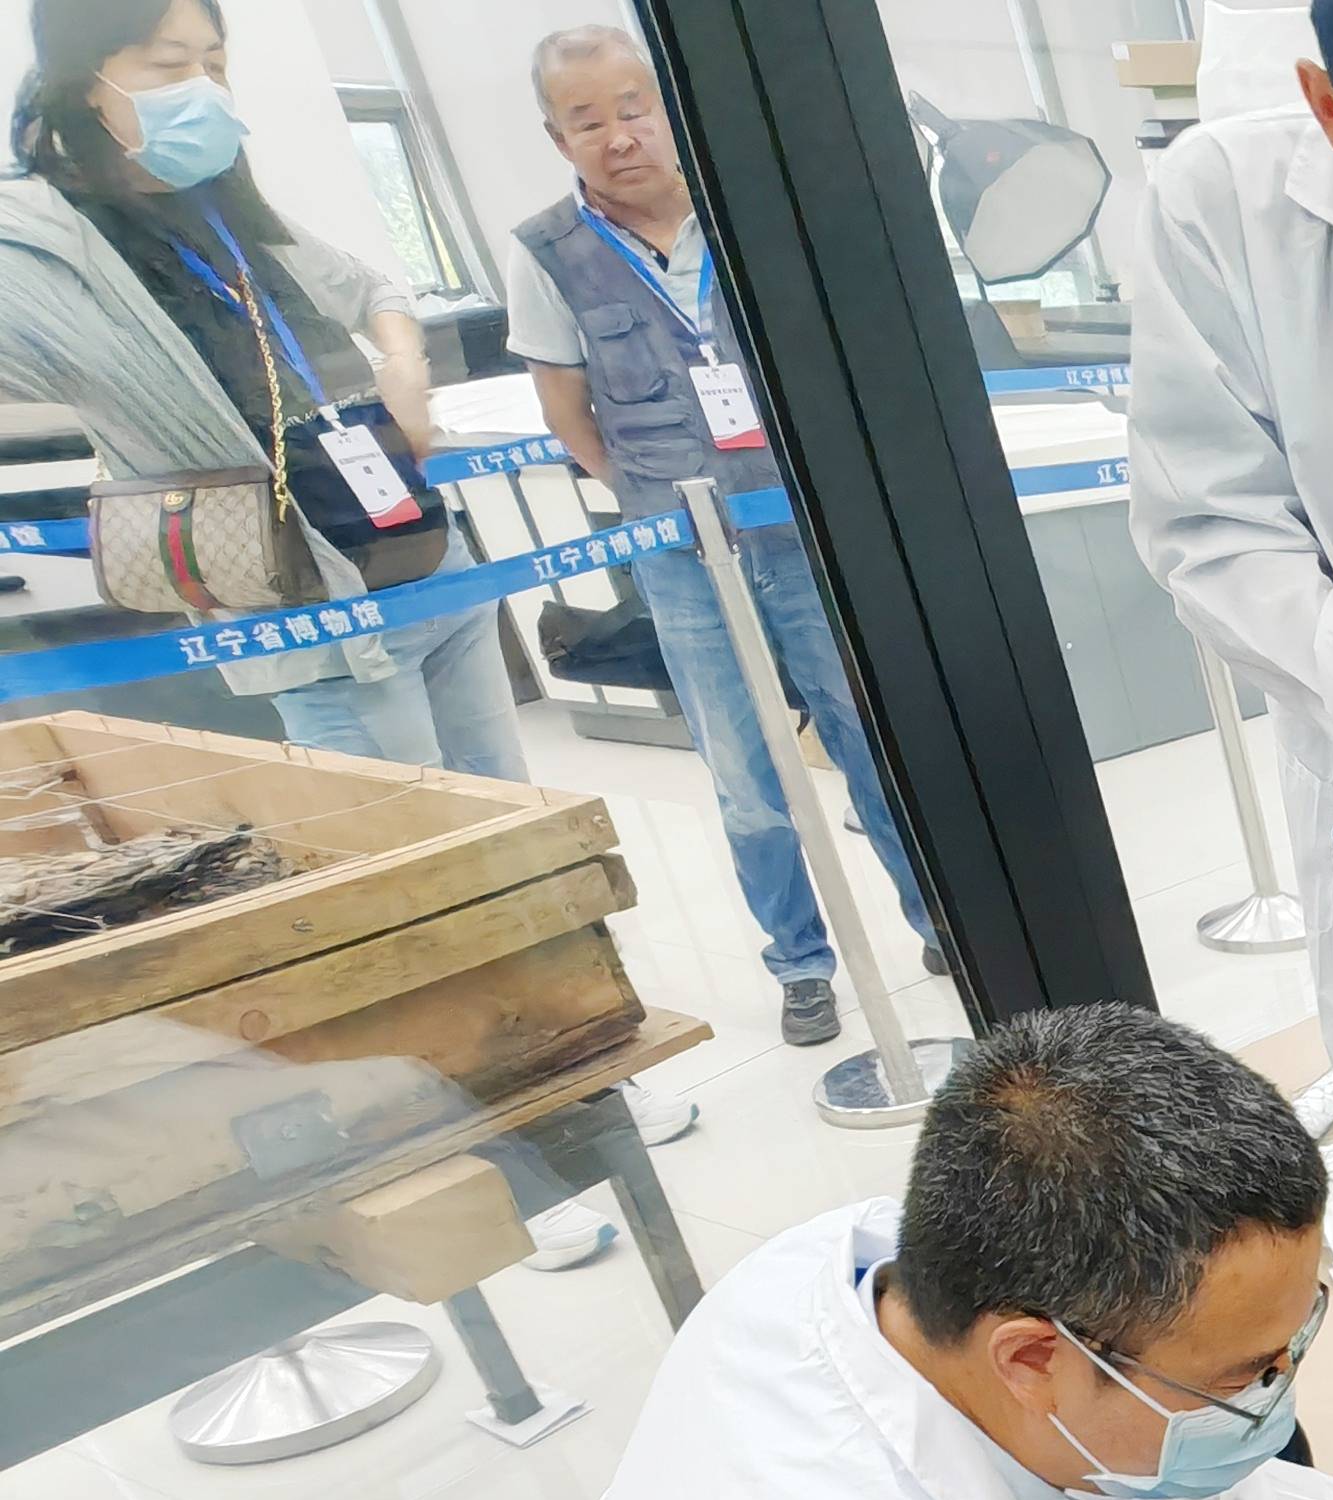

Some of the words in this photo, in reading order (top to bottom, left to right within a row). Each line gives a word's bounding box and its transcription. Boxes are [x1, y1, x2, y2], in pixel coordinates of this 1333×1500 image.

[533, 517, 681, 581] 辽宁省博物馆
[178, 599, 385, 665] 辽宁省博物馆
